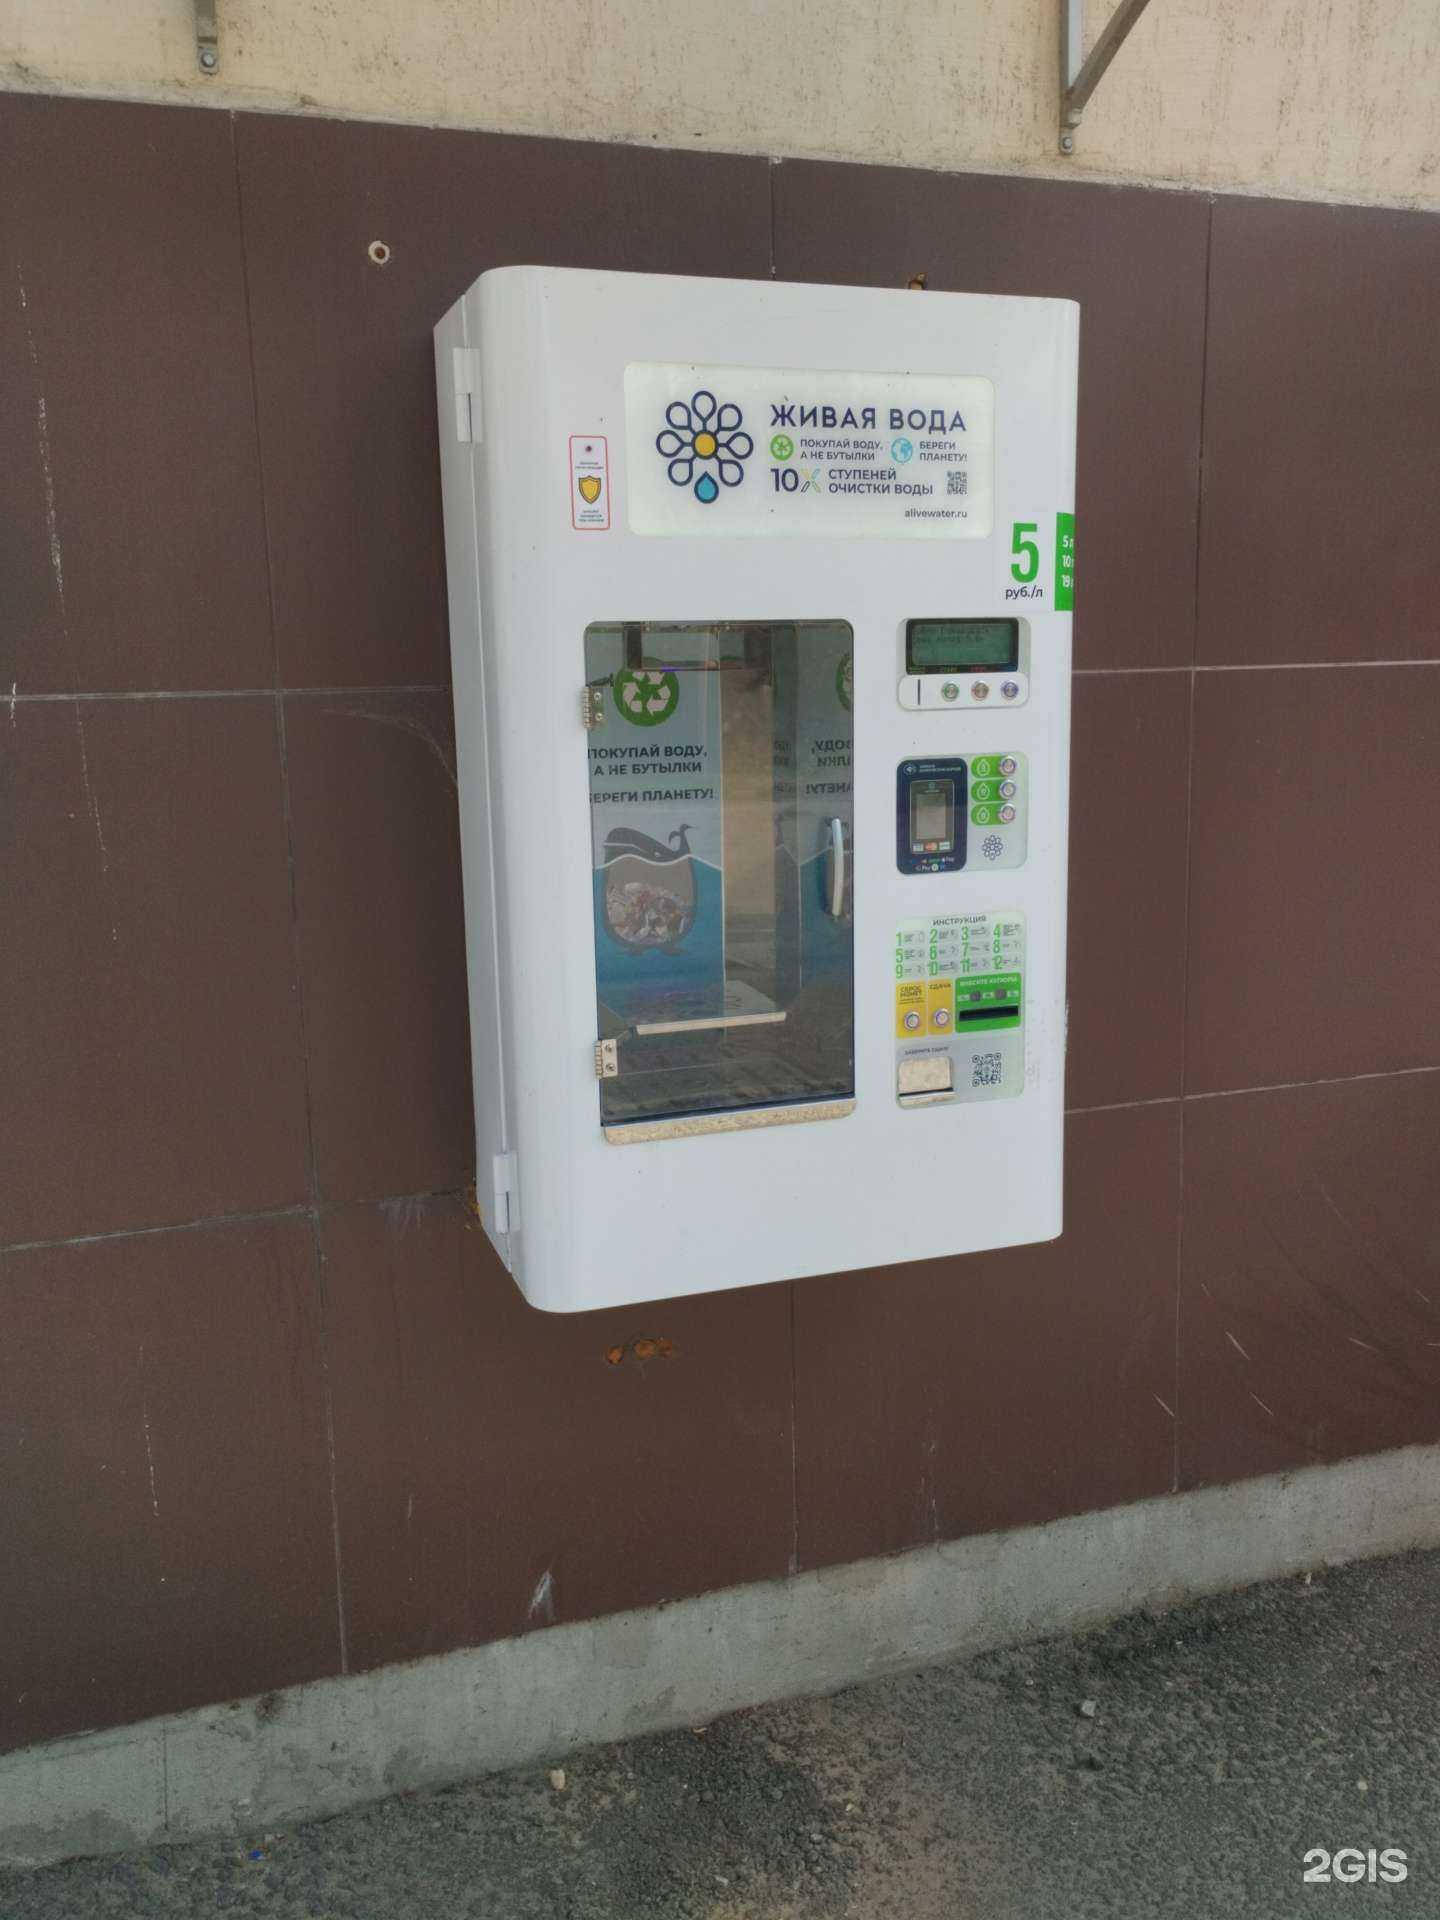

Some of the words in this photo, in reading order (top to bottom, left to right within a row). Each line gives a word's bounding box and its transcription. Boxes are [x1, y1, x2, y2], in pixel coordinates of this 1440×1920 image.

[770, 404, 876, 429] ЖИВАЯ
[889, 408, 967, 435] ВОДА
[800, 438, 850, 449] ПОКУПАЙ
[853, 440, 883, 450] ВОДУ,
[919, 440, 956, 450] БЕРЕГИ
[800, 451, 808, 460] А
[810, 451, 824, 460] НЕ
[826, 451, 875, 461] БУТЫЛКИ
[919, 452, 967, 462] ПЛАНЕТУ!
[770, 468, 799, 492] 10
[828, 467, 897, 481] СТУПЕНЕЙ
[828, 483, 891, 495] ОЧИСТКИ
[894, 484, 933, 496] ВОДЫ
[904, 507, 968, 518] alivewater.ru
[1010, 522, 1040, 583] 5
[1005, 585, 1043, 600] руб./л
[664, 745, 708, 758] ВОДУ,
[593, 765, 605, 776] А
[608, 764, 628, 775] НЕ
[632, 762, 702, 775] БУТЫЛКИ
[642, 788, 713, 801] ПЛАНЕТУ!
[933, 916, 986, 926] ИНСТРУКЦИЯ
[929, 928, 938, 943] 2
[961, 926, 969, 940] 3
[993, 923, 1001, 937] 4
[929, 945, 937, 960] 6
[962, 942, 969, 957] 7
[993, 940, 1000, 953] 8
[896, 948, 903, 963] 5
[896, 964, 903, 979] 9
